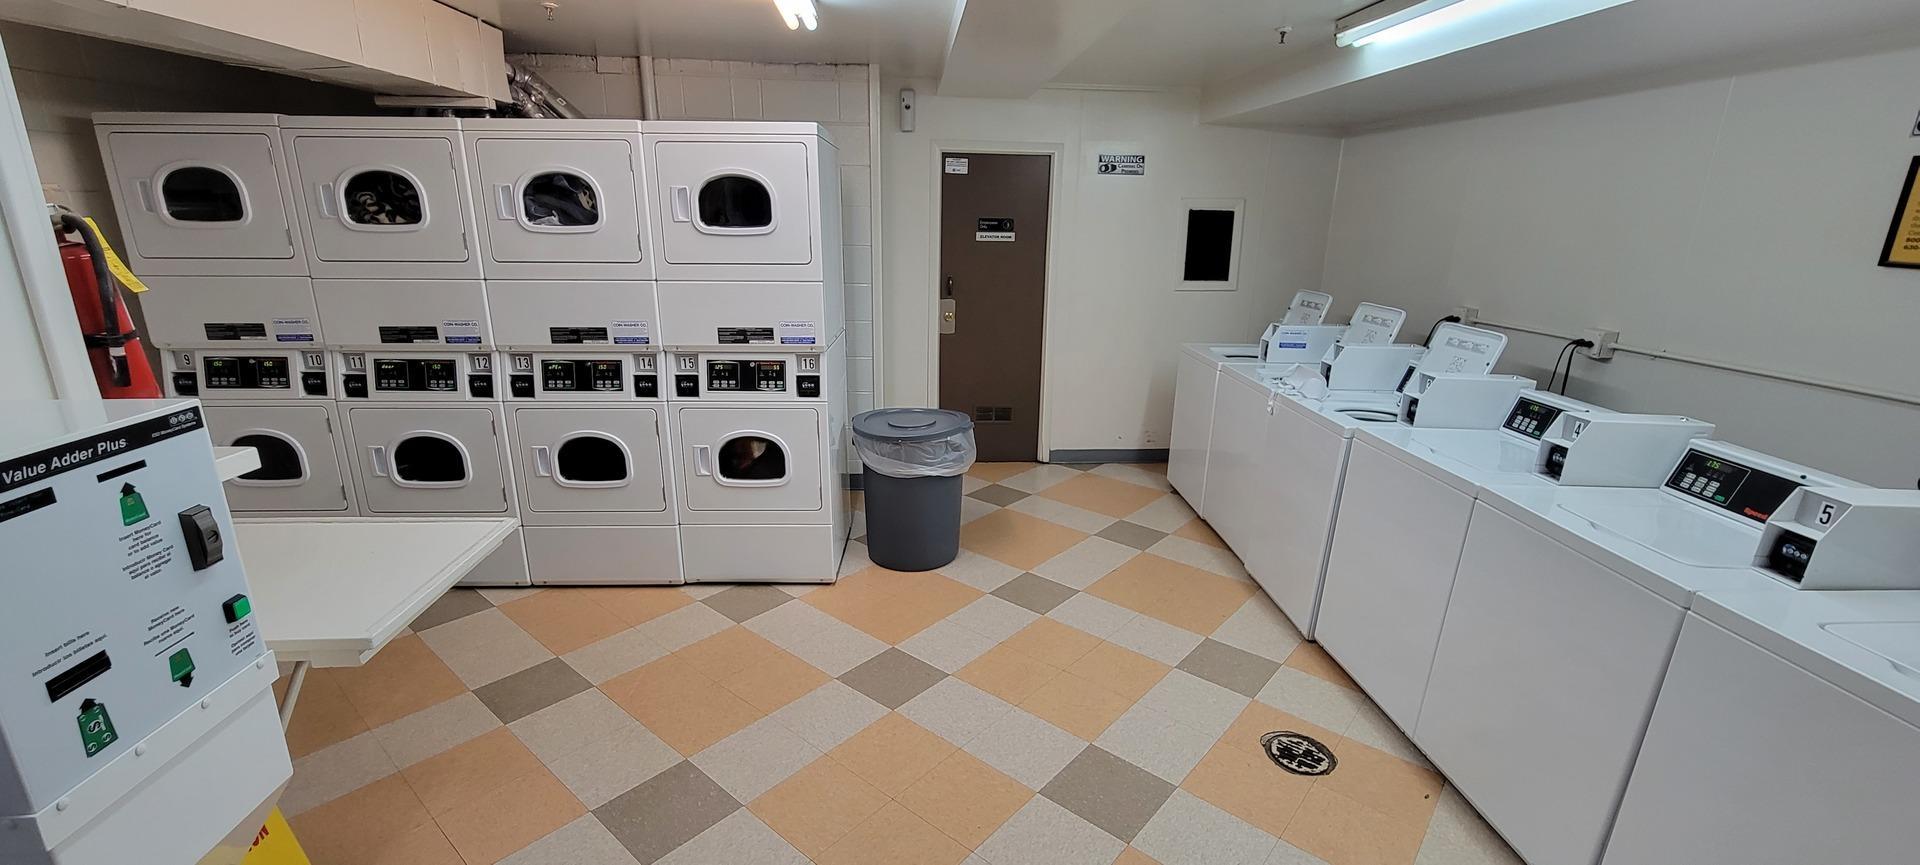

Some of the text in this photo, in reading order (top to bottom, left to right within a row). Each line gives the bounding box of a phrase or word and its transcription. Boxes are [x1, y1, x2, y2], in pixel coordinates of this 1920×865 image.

[1100, 155, 1142, 163] WARNING
[184, 354, 190, 366] 9
[309, 354, 322, 366] 10
[352, 356, 364, 368] 11
[476, 357, 488, 369] 12
[517, 358, 529, 368] 13
[641, 358, 652, 368] 14
[682, 358, 694, 369] 15
[803, 359, 815, 369] 16
[1575, 423, 1582, 437] 4
[2, 438, 127, 484] Value Adder Plus
[1819, 504, 1834, 525] 5
[119, 520, 162, 542] Insert MoneyCard
[45, 645, 63, 657] Insert
